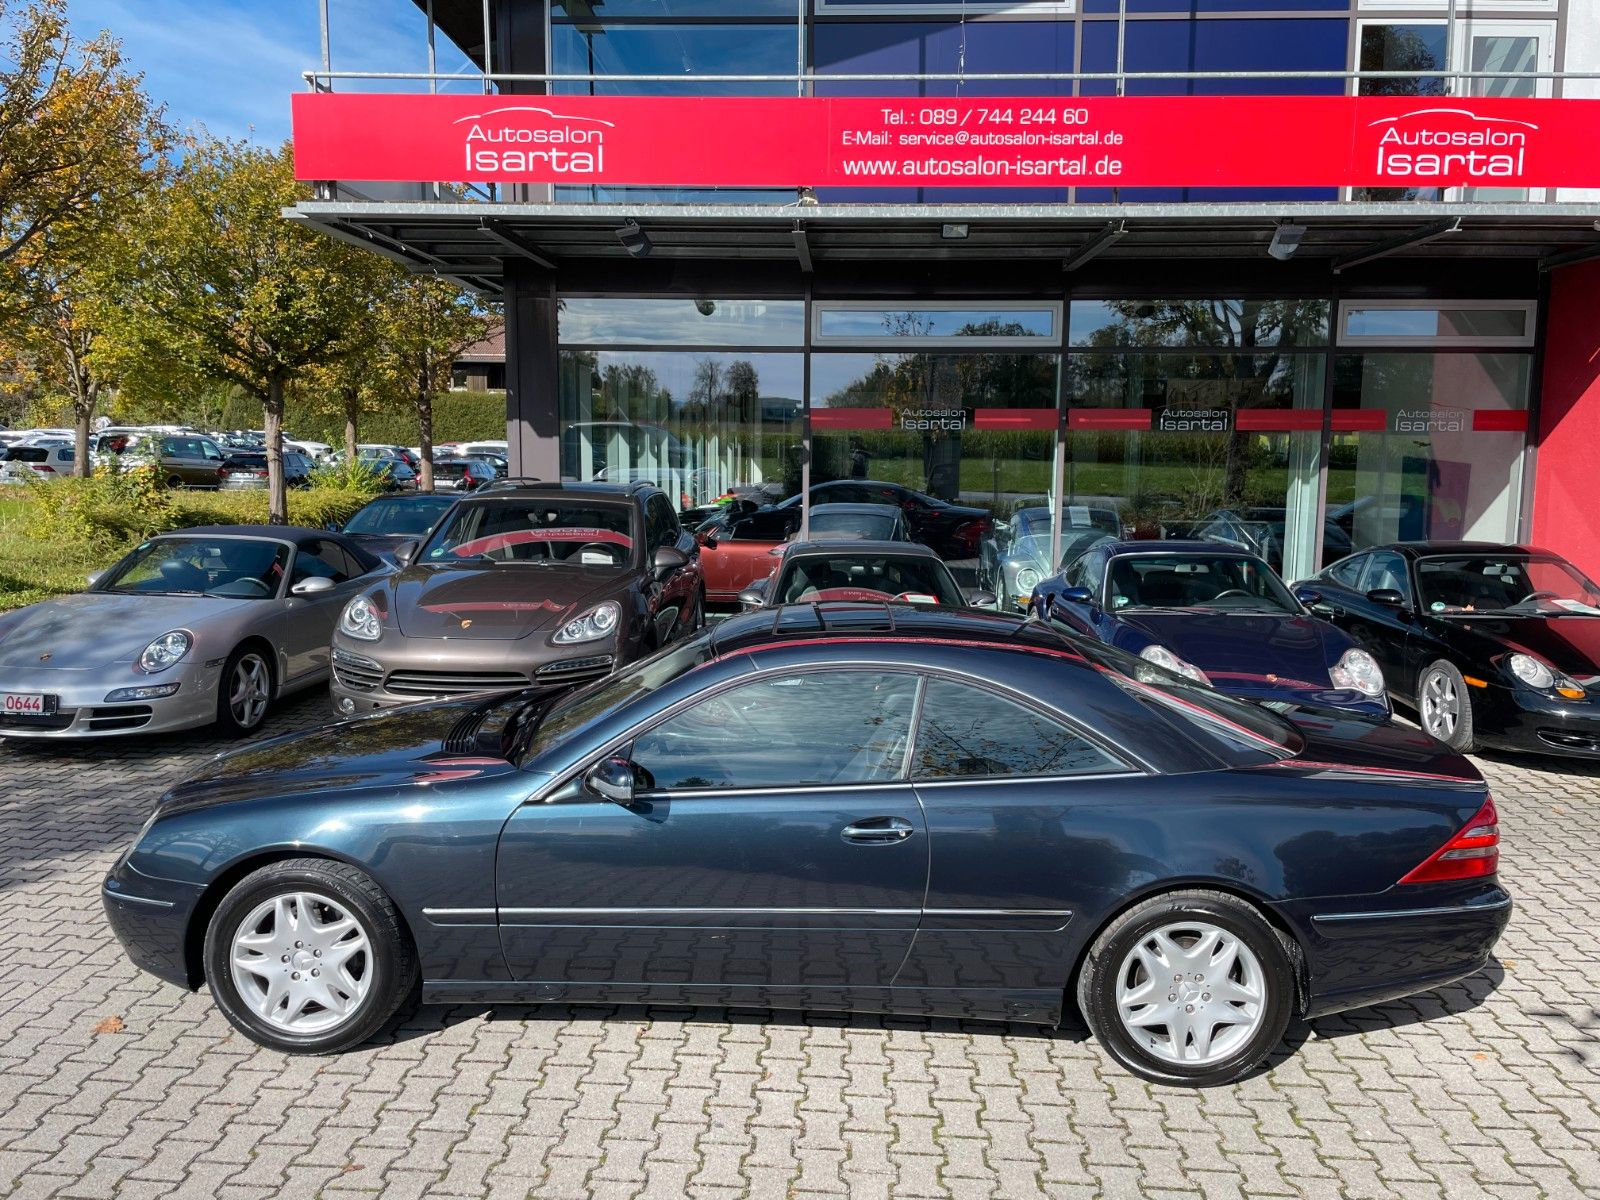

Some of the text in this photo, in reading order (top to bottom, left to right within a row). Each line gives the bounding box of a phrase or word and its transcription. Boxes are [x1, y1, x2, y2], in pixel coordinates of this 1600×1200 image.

[880, 108, 915, 125] Tel.:
[919, 108, 958, 125] 089
[977, 108, 1014, 125] 744
[1019, 108, 1057, 125] 244
[1063, 108, 1089, 125] 60
[466, 124, 603, 143] Autosalon
[842, 130, 1124, 146] E-Mail: service@autosalon-isartal.de
[1379, 127, 1526, 146] Autosalon
[465, 143, 603, 173] Isartal
[843, 155, 1123, 176] www.autosalon-isartal.de
[1376, 146, 1525, 177] Isartal
[901, 407, 967, 417] Autosalon
[1161, 408, 1228, 418] Autosalon
[1396, 408, 1465, 418] Autosalon
[901, 416, 967, 430] Isartal
[1160, 417, 1228, 431] Isartal
[1395, 418, 1465, 432] Isartal
[6, 695, 41, 711] 0644
